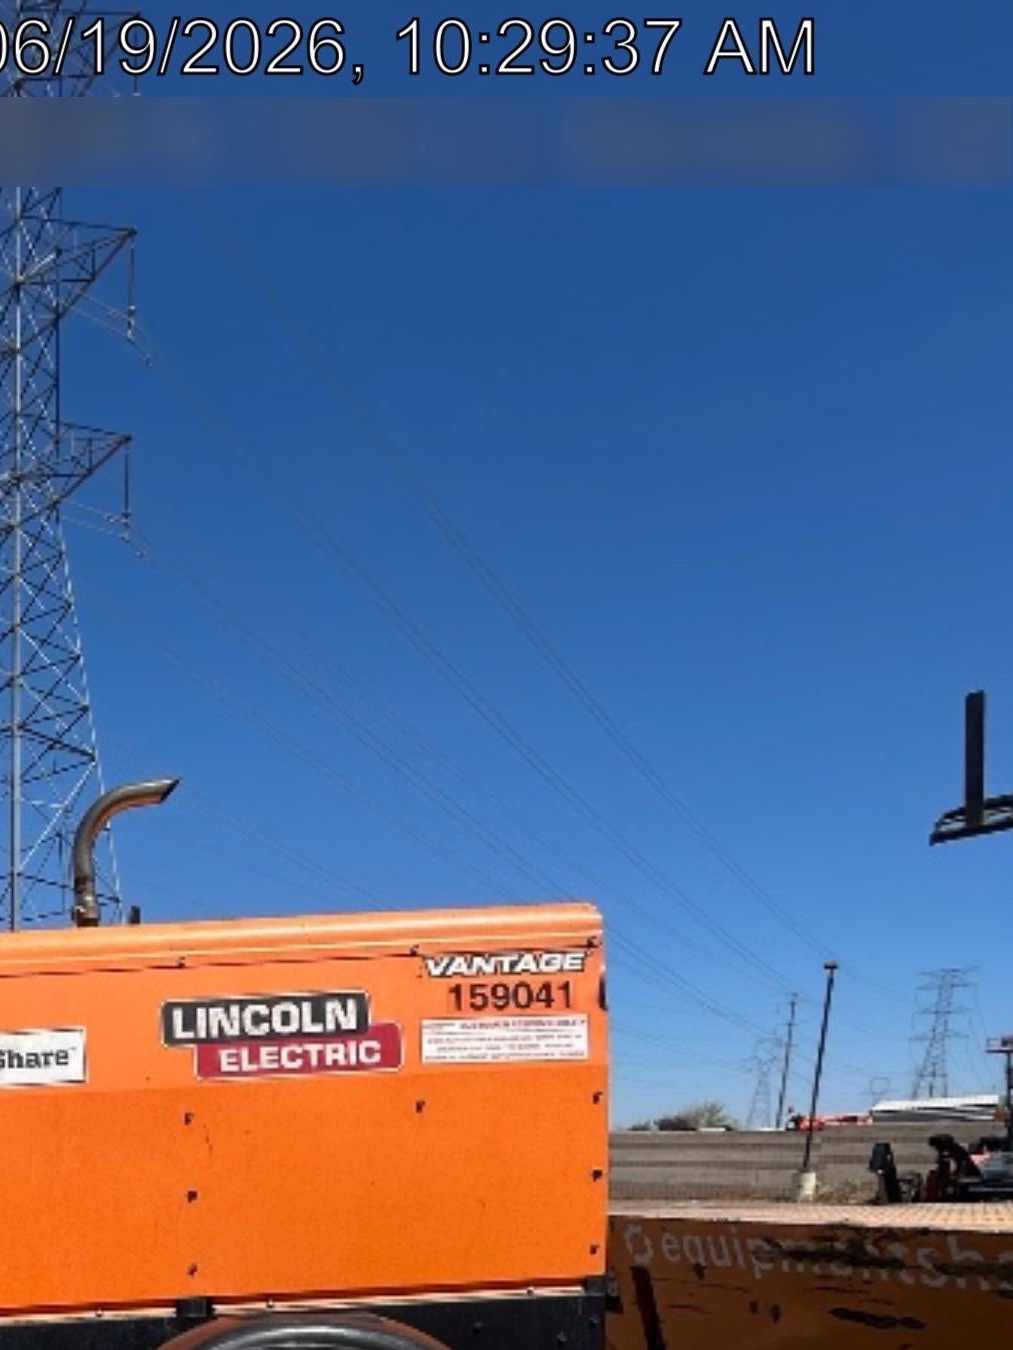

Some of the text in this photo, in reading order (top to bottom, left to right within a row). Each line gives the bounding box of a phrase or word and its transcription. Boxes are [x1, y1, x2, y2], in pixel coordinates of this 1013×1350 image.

[425, 952, 586, 977] VANTAGE
[448, 980, 572, 1011] 159041
[172, 998, 358, 1040] LINCOLN
[219, 1039, 382, 1073] ELECTRIC
